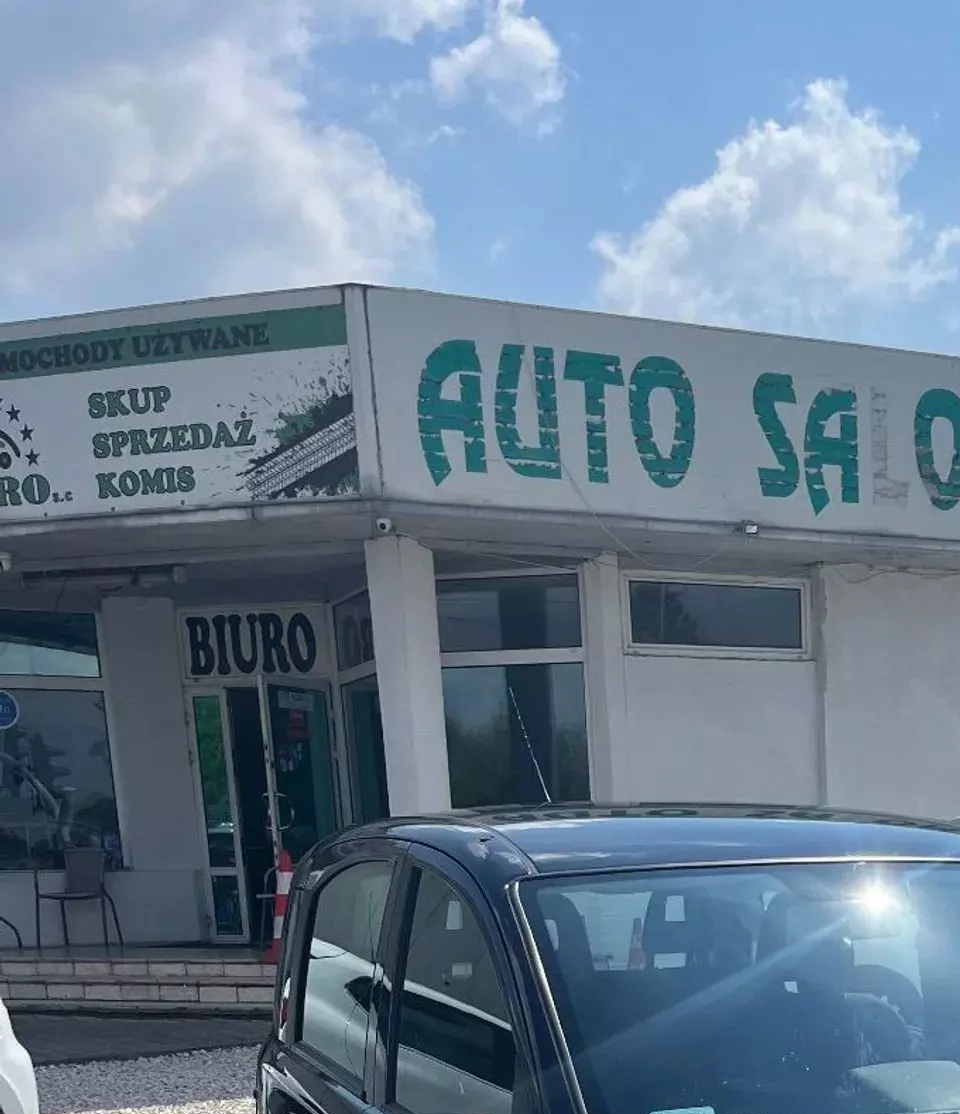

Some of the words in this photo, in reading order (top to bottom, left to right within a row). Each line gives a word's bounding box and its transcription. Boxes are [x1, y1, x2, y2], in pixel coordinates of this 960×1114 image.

[88, 386, 171, 418] SKUP
[416, 339, 696, 488] AUTO
[92, 411, 256, 458] SPRZEDAŻ
[95, 466, 195, 499] KOMIS
[186, 612, 317, 676] BIURO
